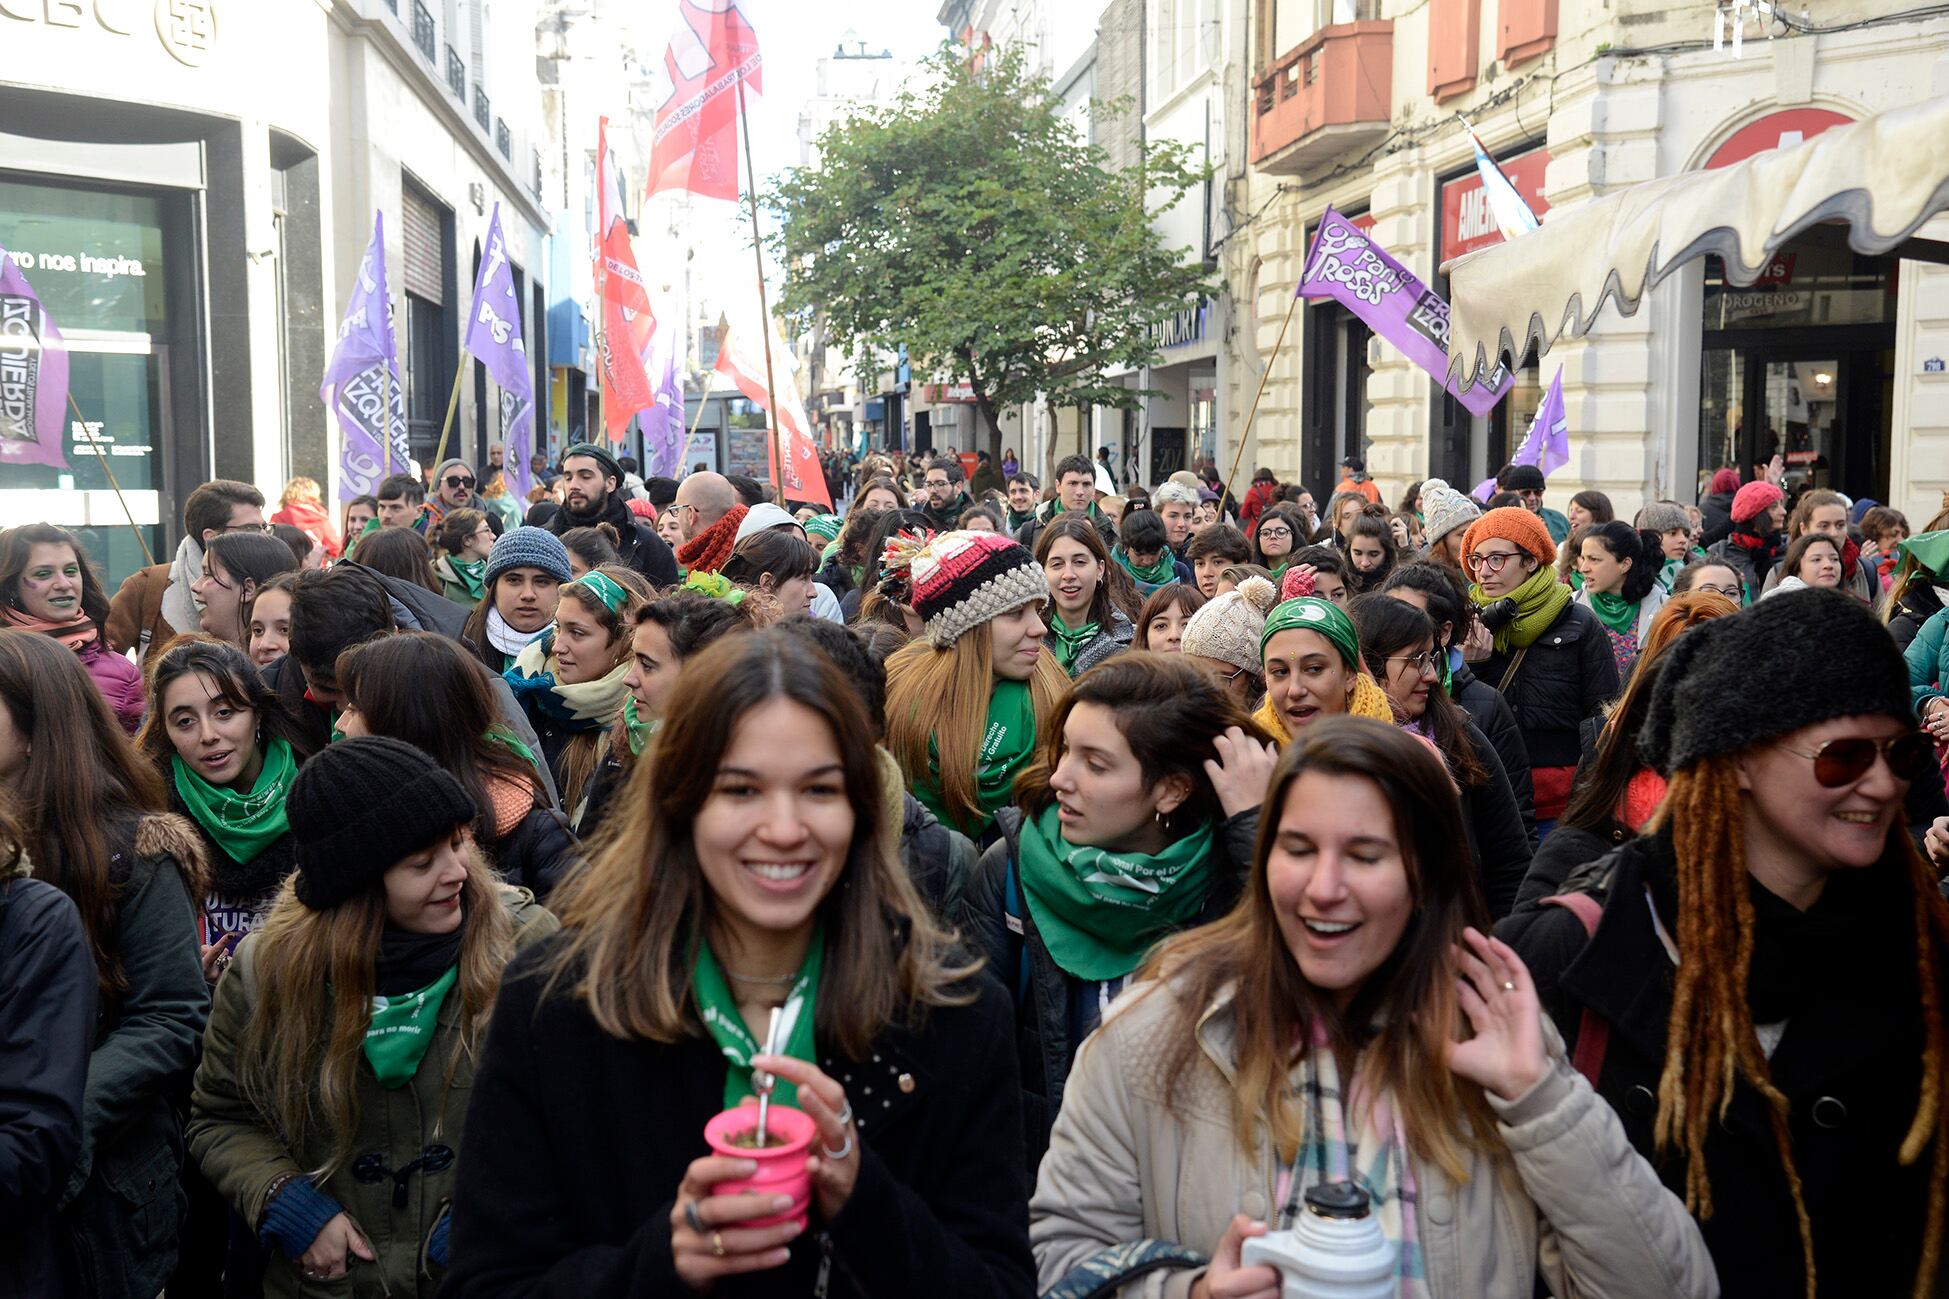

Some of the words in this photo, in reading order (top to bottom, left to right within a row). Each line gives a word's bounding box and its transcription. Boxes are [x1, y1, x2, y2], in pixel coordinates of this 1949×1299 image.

[39, 253, 77, 271] nos
[988, 726, 1007, 755] Gratuito
[1135, 864, 1153, 876] Por
[386, 1026, 398, 1034] no
[398, 1026, 421, 1035] morir
